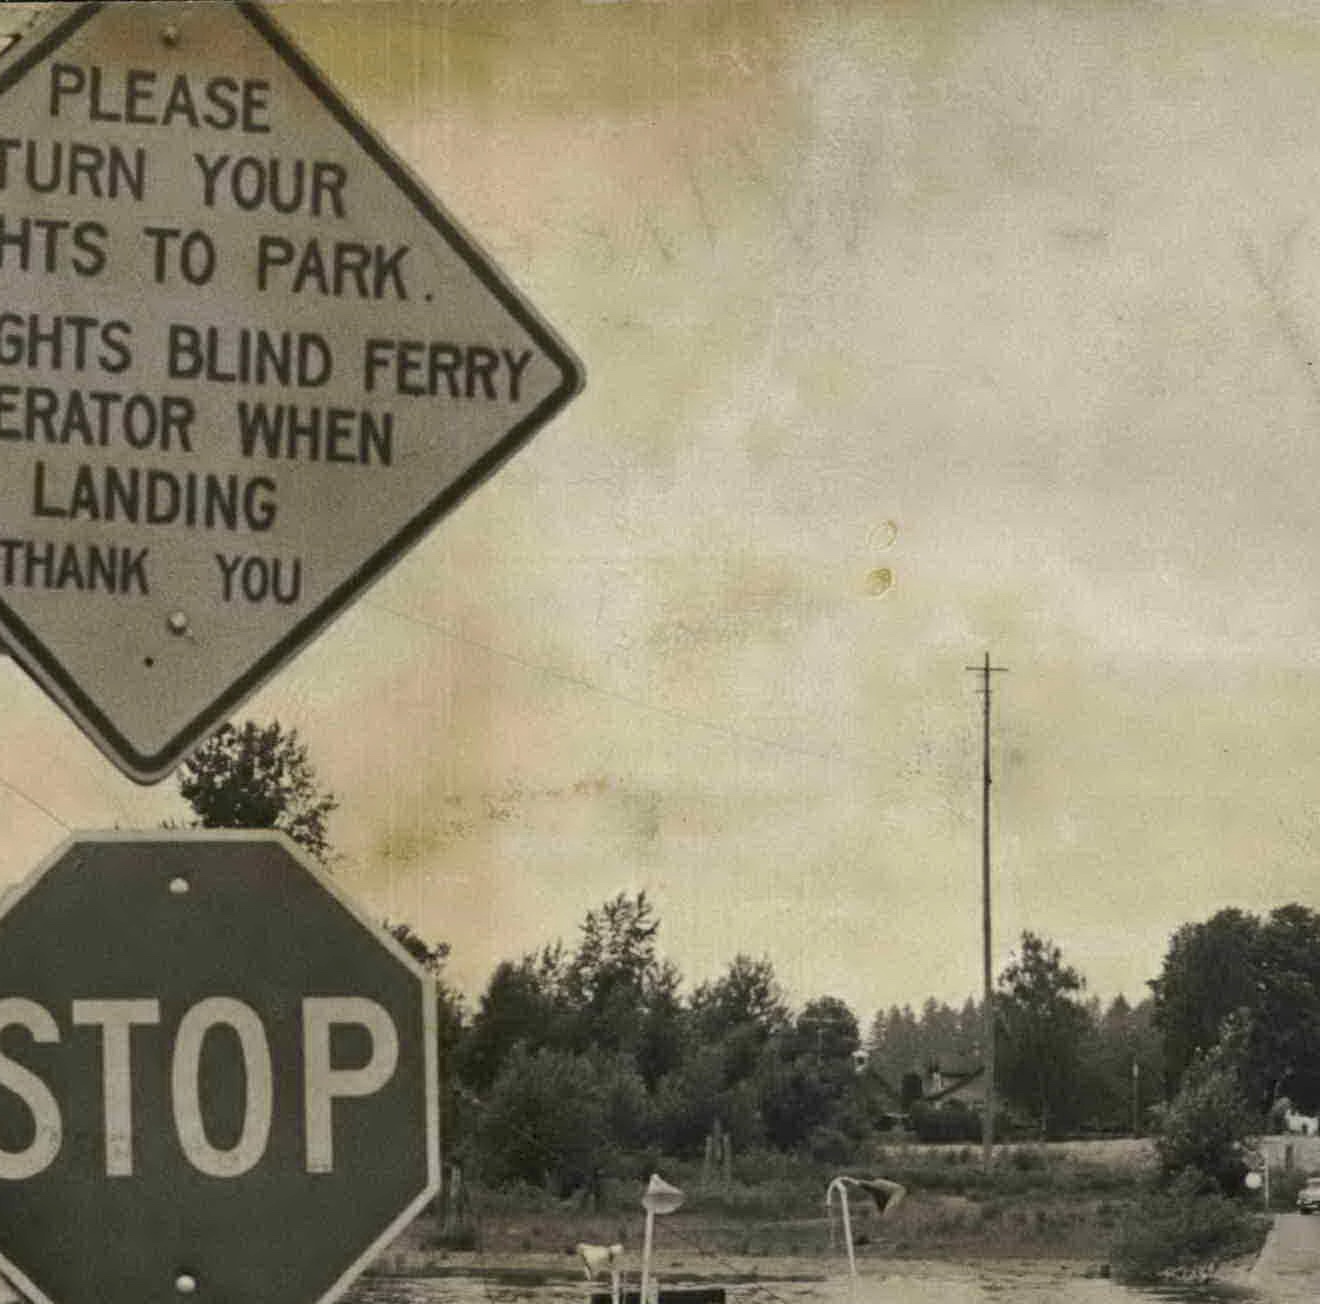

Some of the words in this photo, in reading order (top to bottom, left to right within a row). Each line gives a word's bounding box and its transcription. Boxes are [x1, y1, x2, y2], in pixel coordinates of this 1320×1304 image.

[49, 62, 272, 134] PLEASE
[194, 153, 348, 219] YOUR
[143, 227, 217, 286] TO
[168, 324, 333, 390] BLIND
[363, 339, 533, 402] FERRY
[237, 406, 394, 468] WHEN
[32, 461, 278, 533] LANDING
[215, 553, 302, 604] YOU
